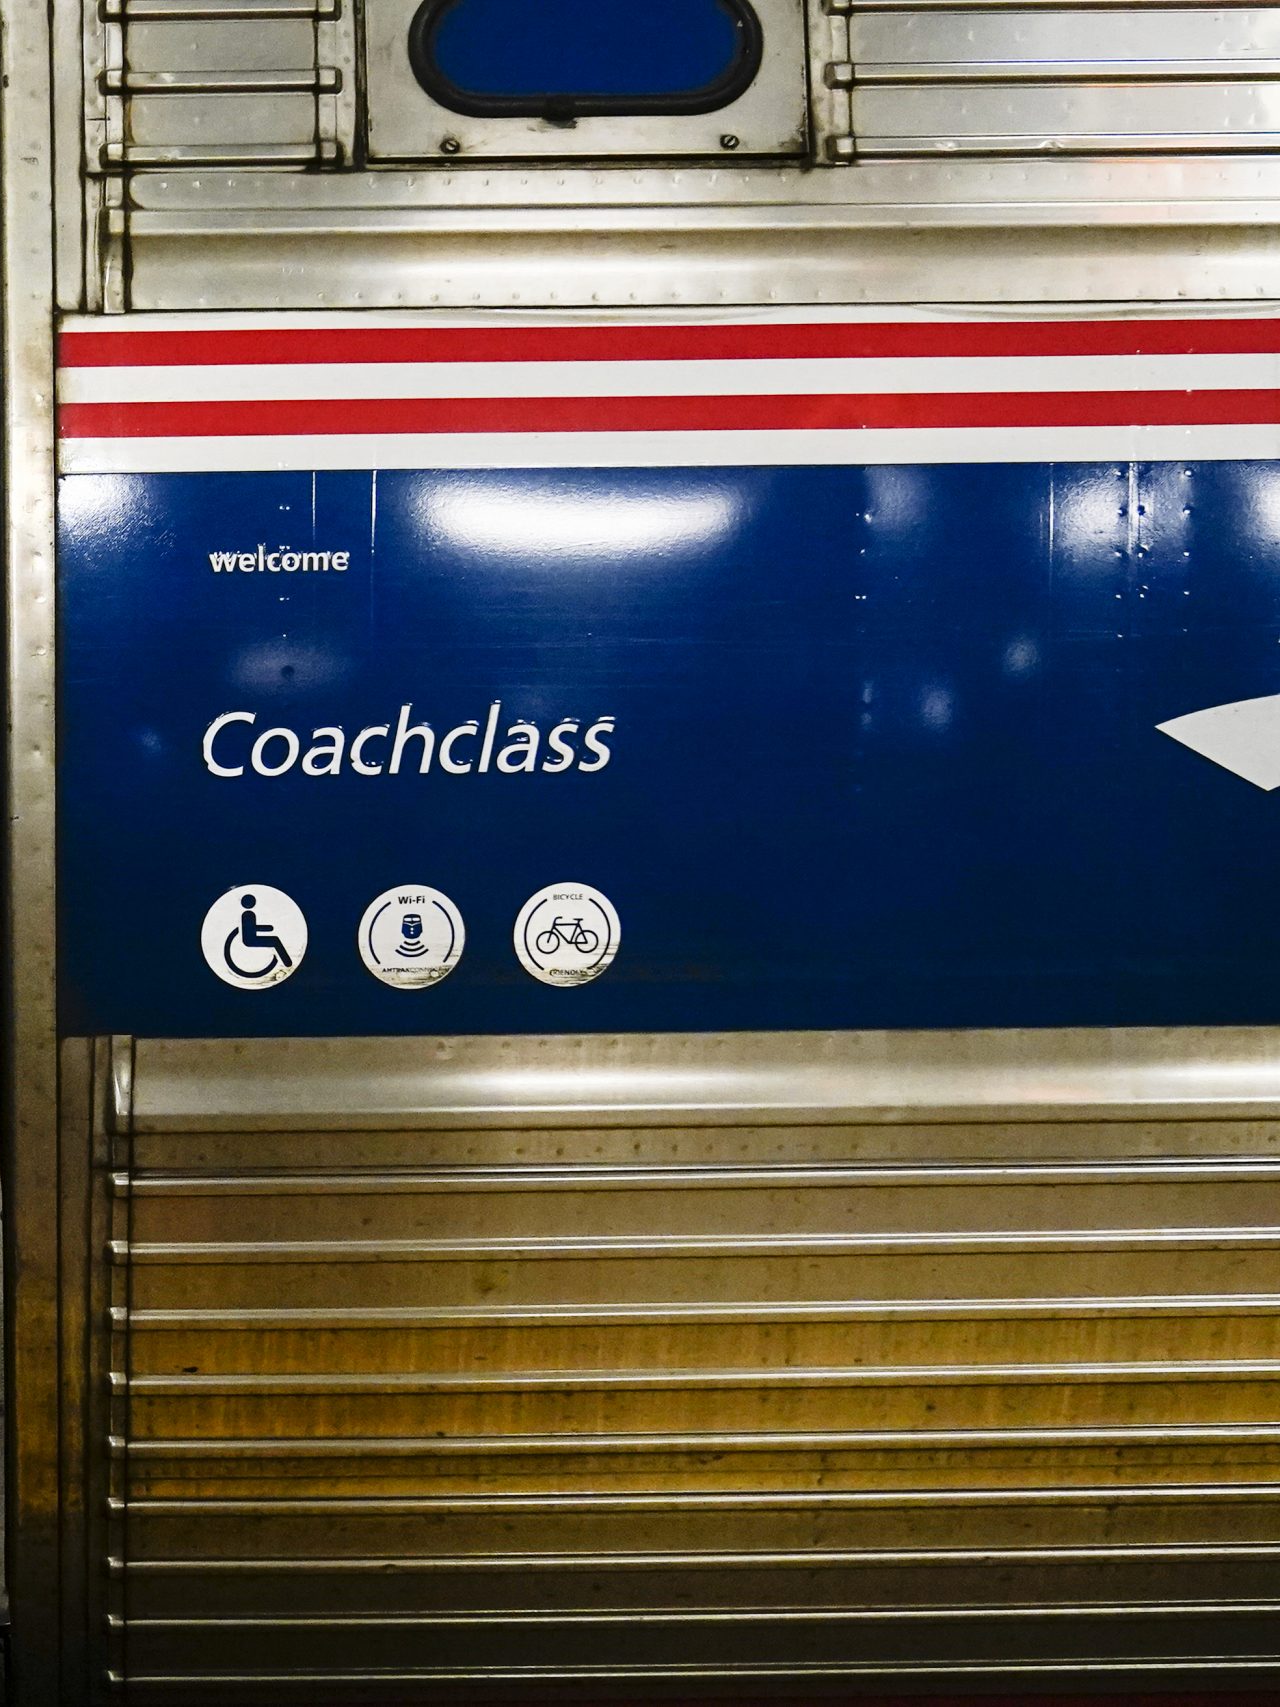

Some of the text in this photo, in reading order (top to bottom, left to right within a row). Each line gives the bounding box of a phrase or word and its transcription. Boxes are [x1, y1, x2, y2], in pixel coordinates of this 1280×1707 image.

[209, 545, 350, 573] welcome
[201, 700, 617, 778] Coachclass
[397, 895, 426, 905] Wi-Fi
[552, 893, 584, 901] BICYCLE
